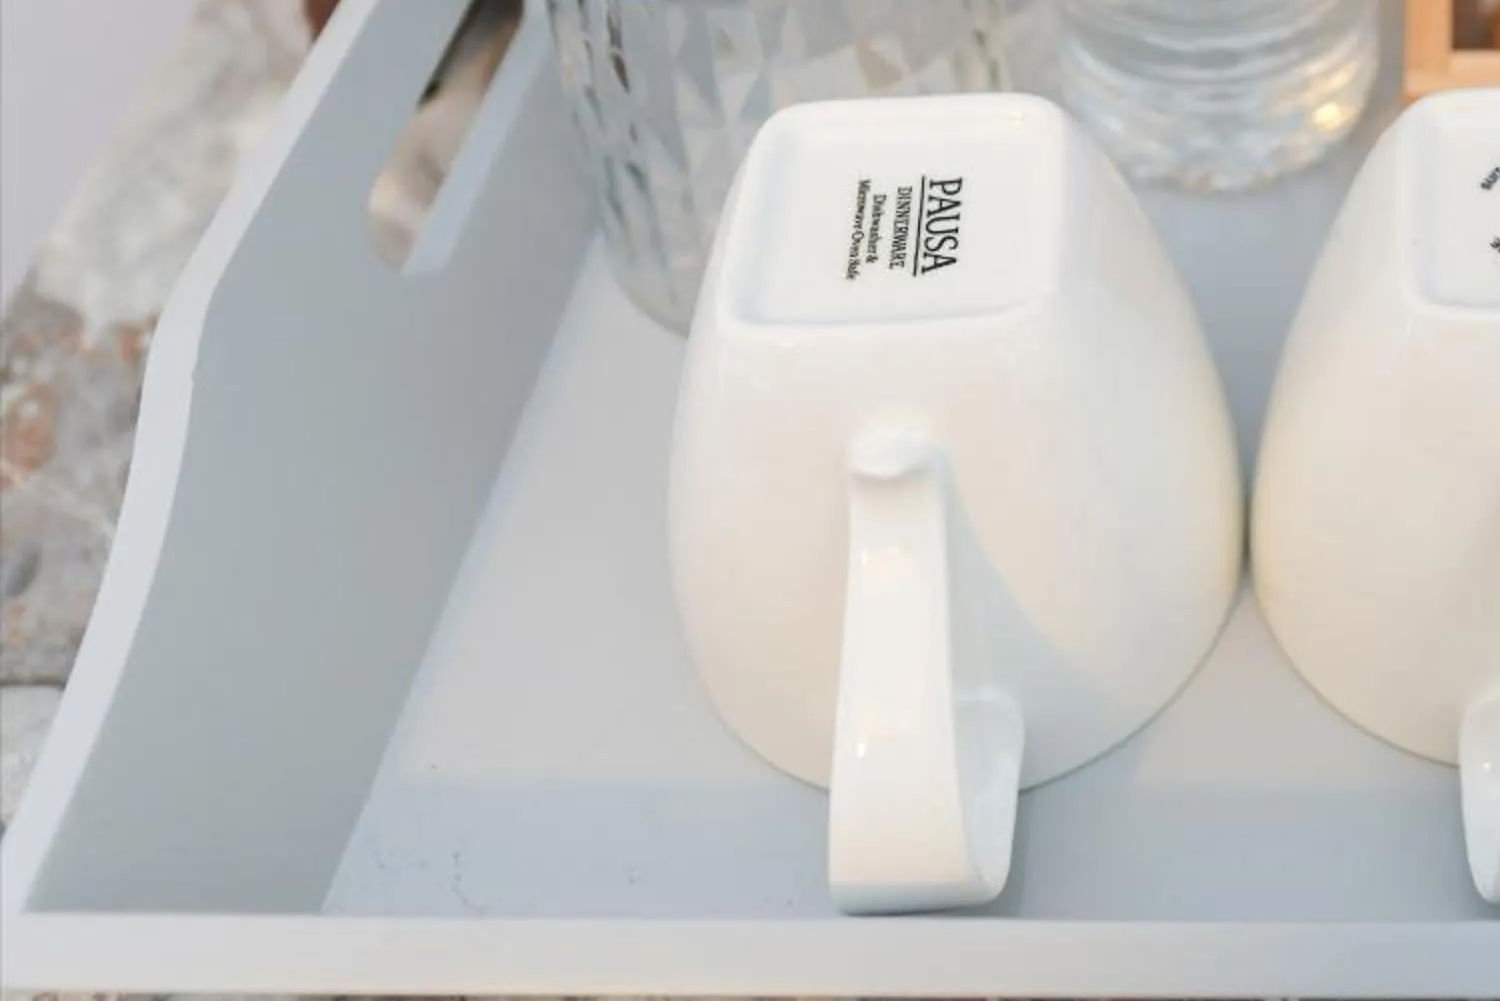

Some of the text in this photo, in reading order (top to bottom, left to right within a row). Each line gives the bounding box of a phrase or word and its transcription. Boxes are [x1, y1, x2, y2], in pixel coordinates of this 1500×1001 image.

[865, 194, 887, 264] Dishwasher &
[889, 186, 912, 270] DINNERWARE
[921, 177, 963, 274] PAUSA
